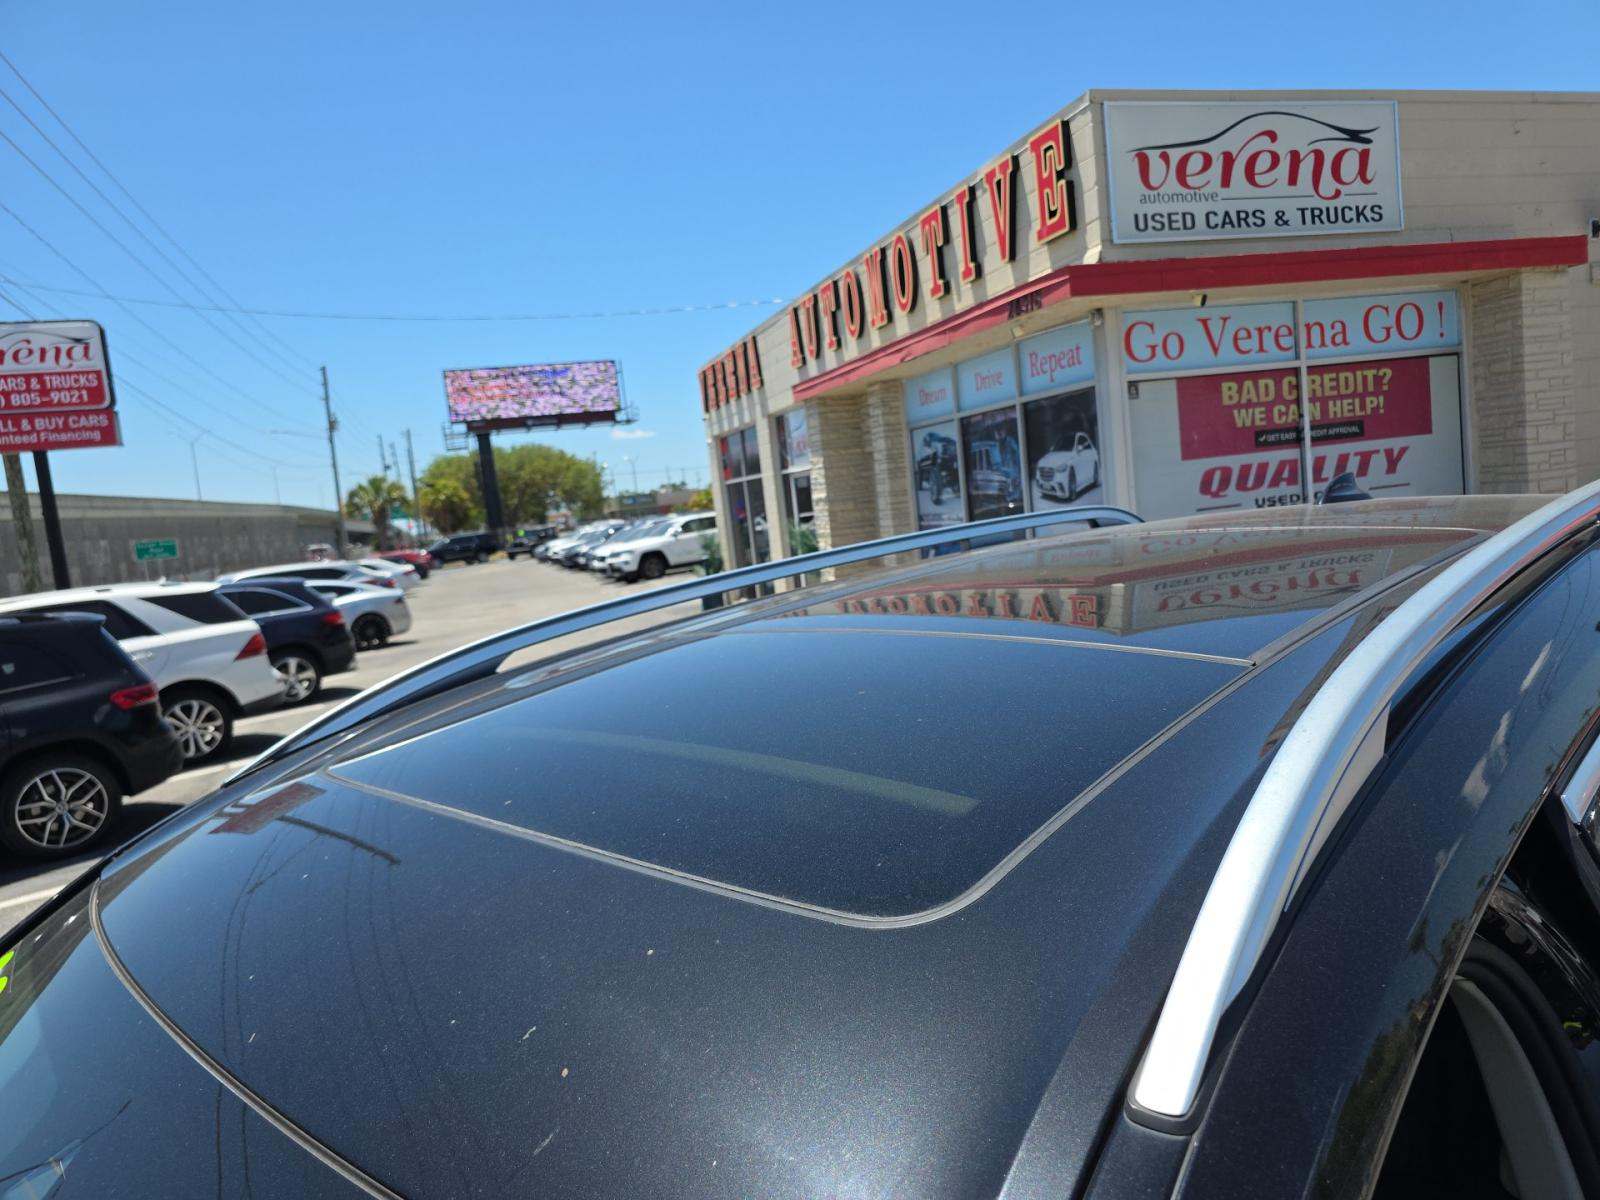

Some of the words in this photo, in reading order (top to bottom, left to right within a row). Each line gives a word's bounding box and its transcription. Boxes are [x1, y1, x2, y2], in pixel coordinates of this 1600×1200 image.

[1131, 129, 1376, 201] verena
[1138, 190, 1219, 205] automotive
[1133, 212, 1196, 233] USED
[1204, 209, 1266, 230] CARS
[1274, 209, 1291, 227] &
[1296, 204, 1384, 226] TRUCKS
[788, 119, 1076, 368] AUTOMOTIVE
[1123, 320, 1186, 363] Go
[1197, 315, 1350, 357] Verena
[1362, 301, 1424, 344] GO
[1437, 300, 1446, 339] !
[1028, 344, 1083, 383] Repeat
[30, 377, 41, 390] &
[43, 373, 98, 389] TRUCKS
[1220, 377, 1276, 406] BAD
[1281, 367, 1393, 403] CREDIT?
[10, 389, 88, 406] 805-9021
[1232, 406, 1267, 428] WE
[1272, 401, 1321, 424] CAN
[1328, 396, 1385, 420] HELP!
[20, 418, 32, 431] &
[35, 415, 65, 431] BUY
[68, 413, 109, 428] CARS
[40, 429, 101, 442] Financing
[1303, 428, 1328, 438] REDIT
[1198, 446, 1410, 498] QUALITY
[1254, 493, 1300, 509] USED
